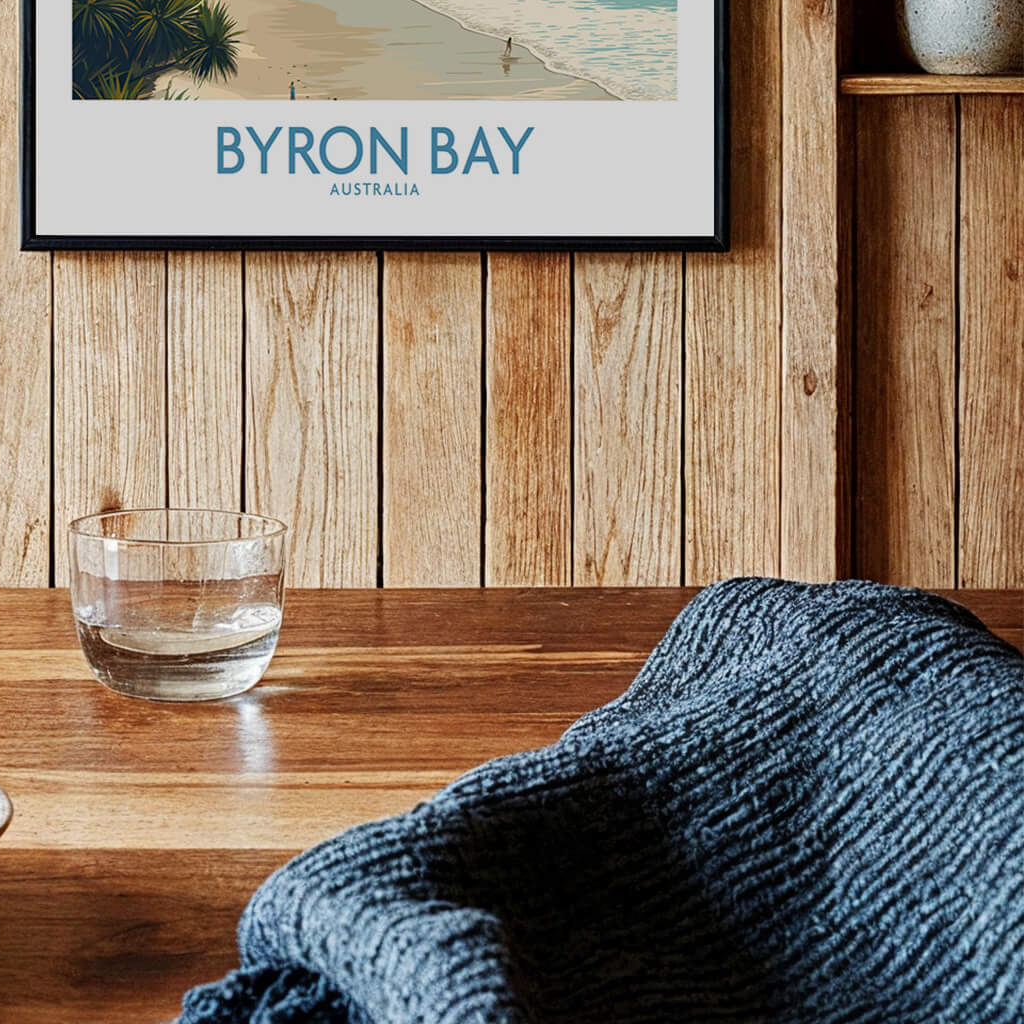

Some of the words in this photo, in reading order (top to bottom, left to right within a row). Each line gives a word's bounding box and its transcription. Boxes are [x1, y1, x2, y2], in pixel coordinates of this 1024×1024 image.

[216, 125, 408, 176] BYRON
[430, 125, 536, 176] BAY
[329, 182, 420, 197] AUSTRALIA
